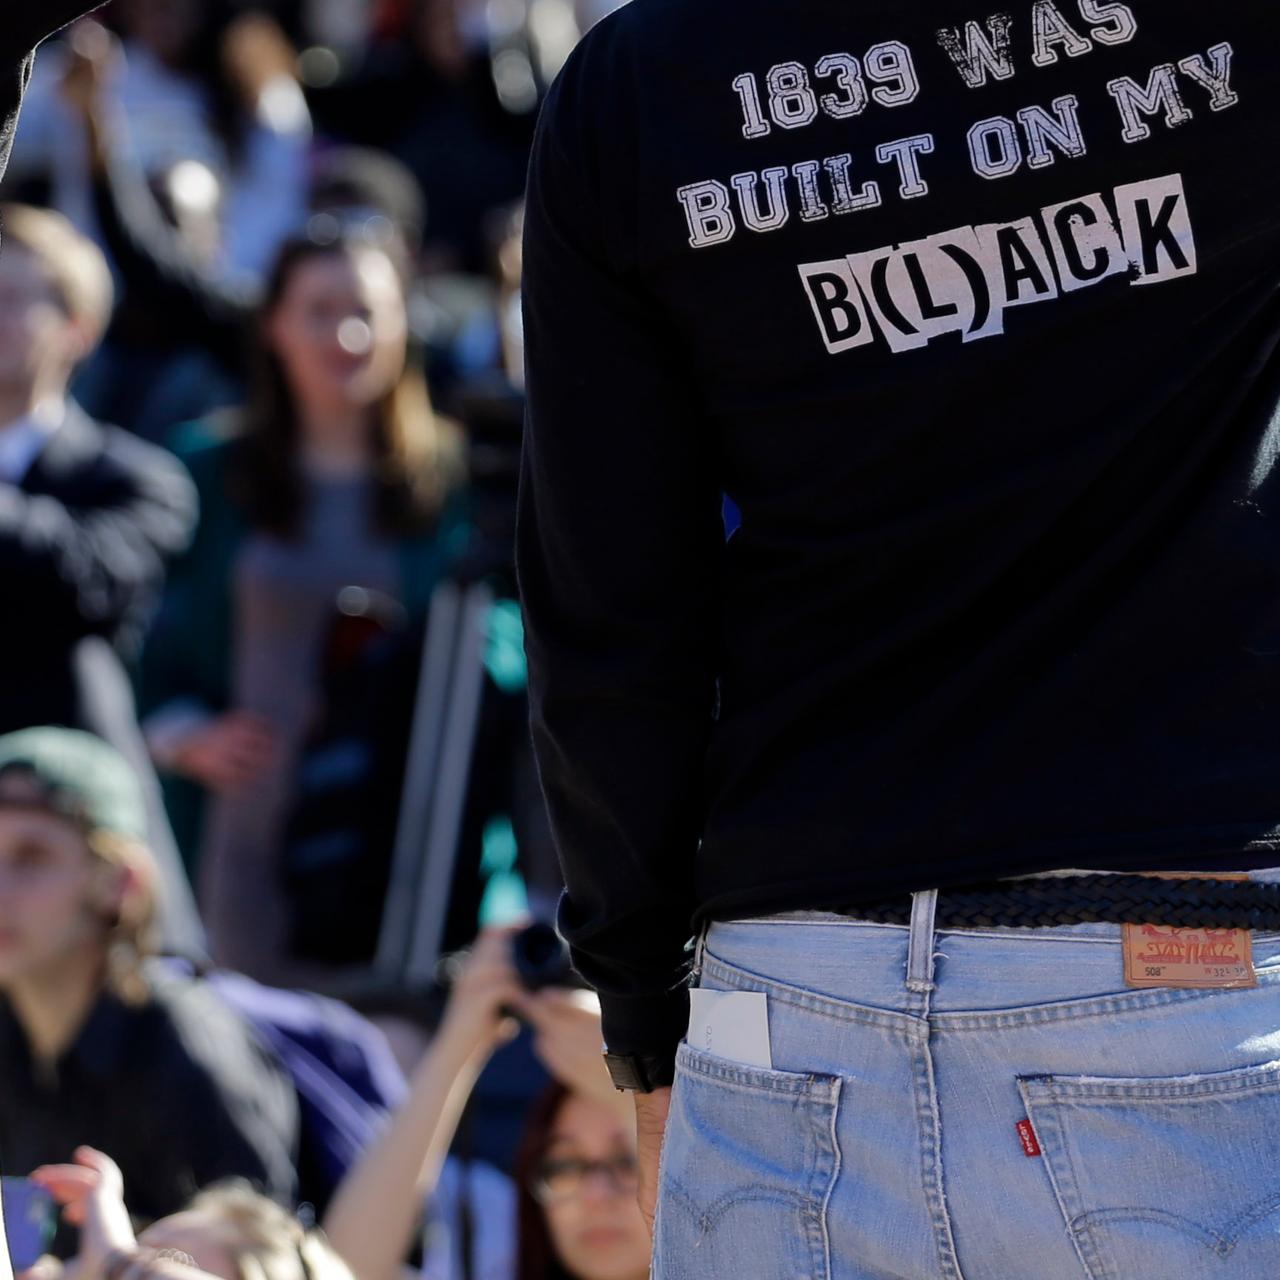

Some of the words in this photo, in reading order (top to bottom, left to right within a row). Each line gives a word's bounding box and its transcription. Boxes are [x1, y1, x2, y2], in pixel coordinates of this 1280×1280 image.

[677, 133, 935, 249] BUILT
[968, 94, 1087, 179] ON
[1107, 41, 1239, 143] MY
[733, 40, 920, 139] 1839
[804, 186, 1192, 345] B(L)ACK
